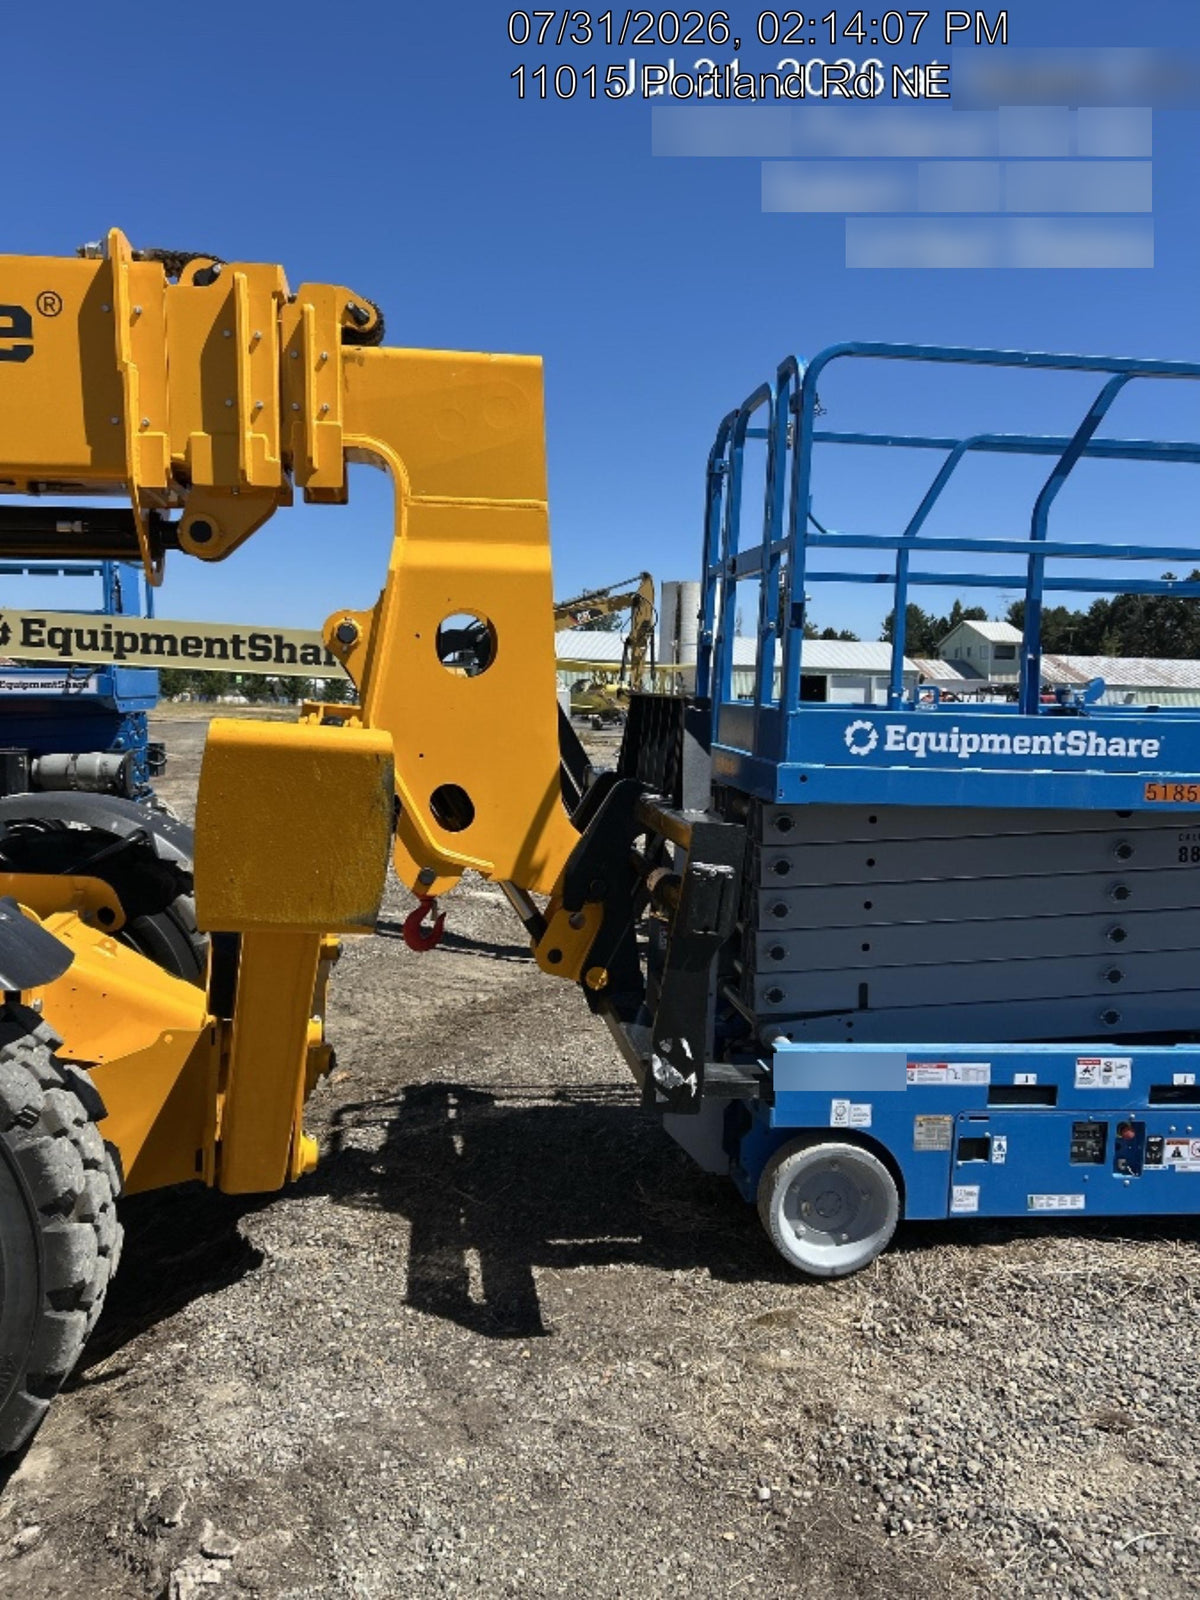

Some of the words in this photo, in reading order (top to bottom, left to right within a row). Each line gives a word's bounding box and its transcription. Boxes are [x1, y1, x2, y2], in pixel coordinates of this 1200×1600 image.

[20, 617, 336, 667] EquipmentShar
[884, 724, 1160, 759] EquipmentShare
[1146, 783, 1198, 802] 5185
